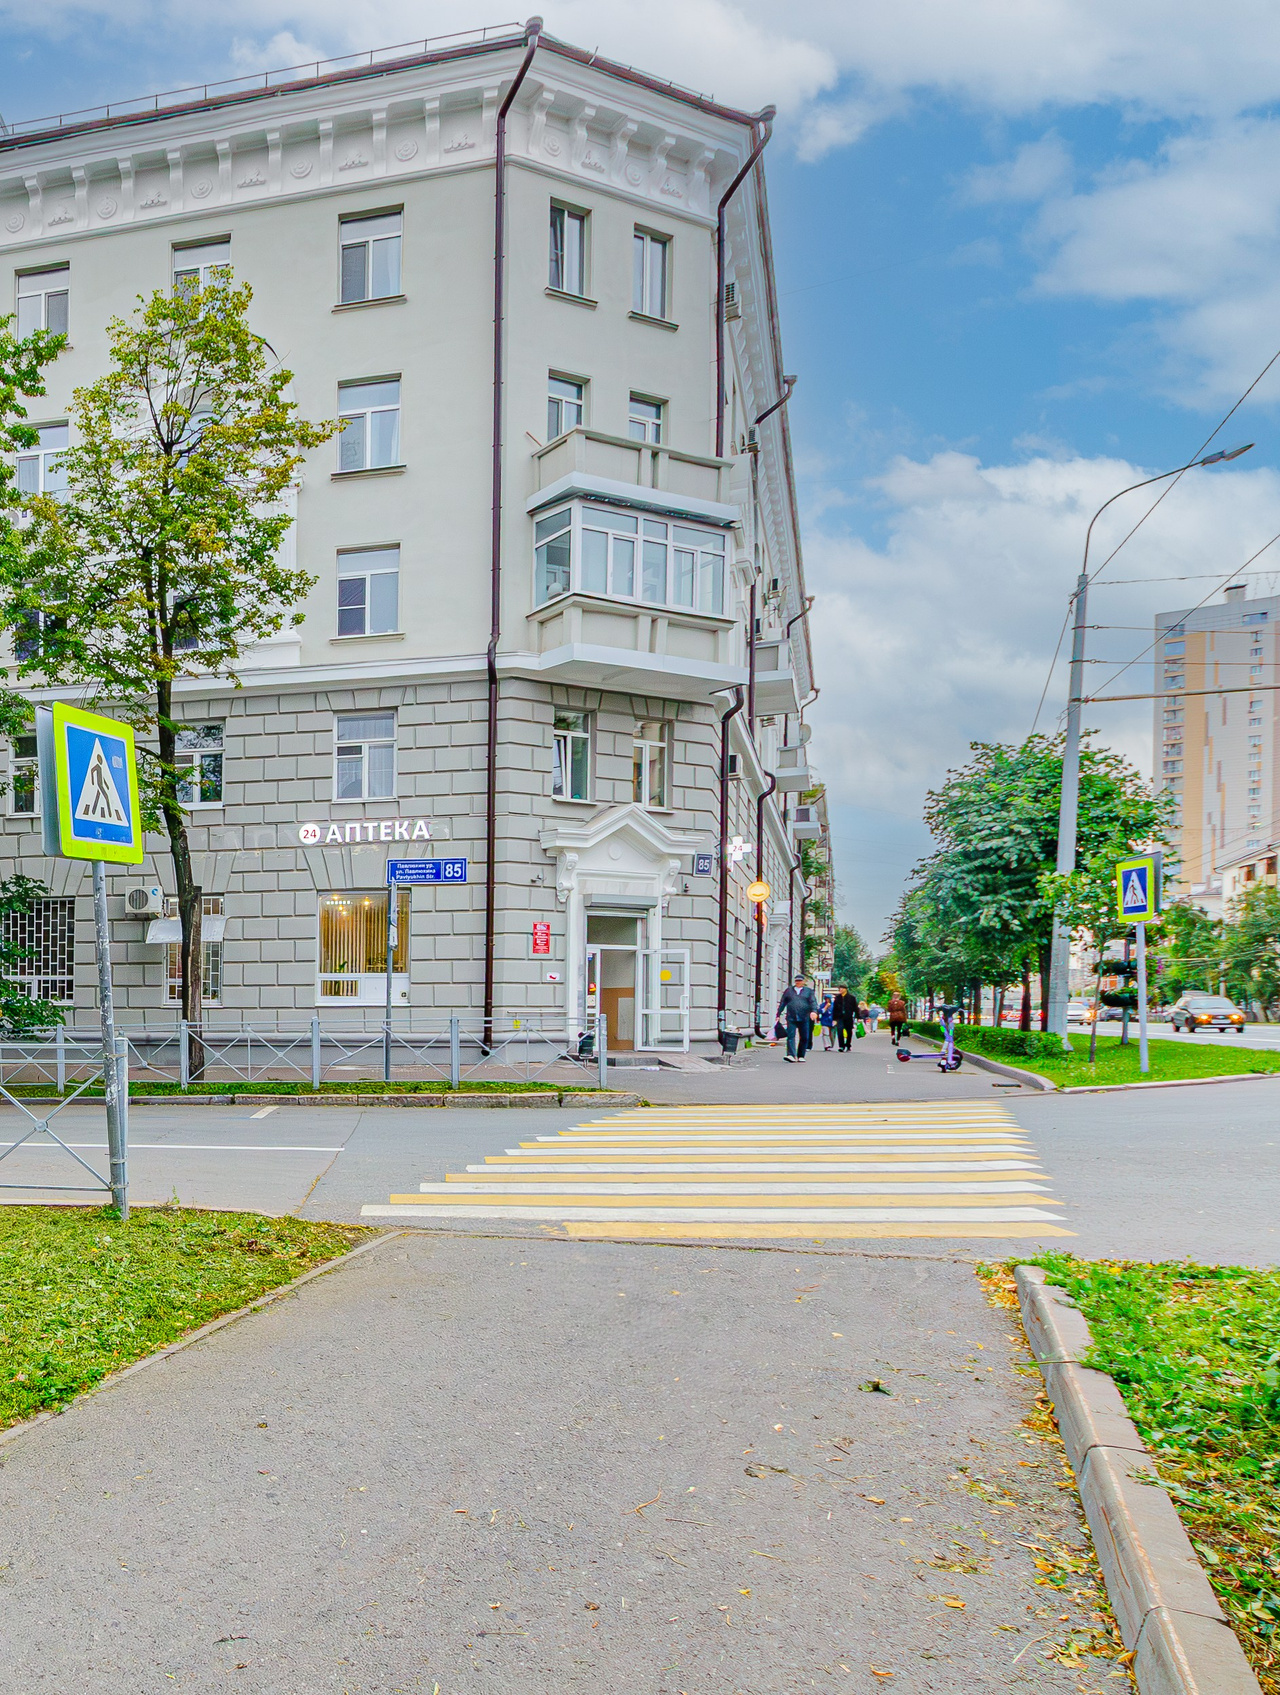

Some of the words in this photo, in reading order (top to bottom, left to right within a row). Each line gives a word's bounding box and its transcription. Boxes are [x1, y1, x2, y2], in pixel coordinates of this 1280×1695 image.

[303, 829, 317, 839] 24
[325, 821, 431, 843] АПТЕКА
[445, 864, 462, 877] 85
[699, 859, 710, 870] 85
